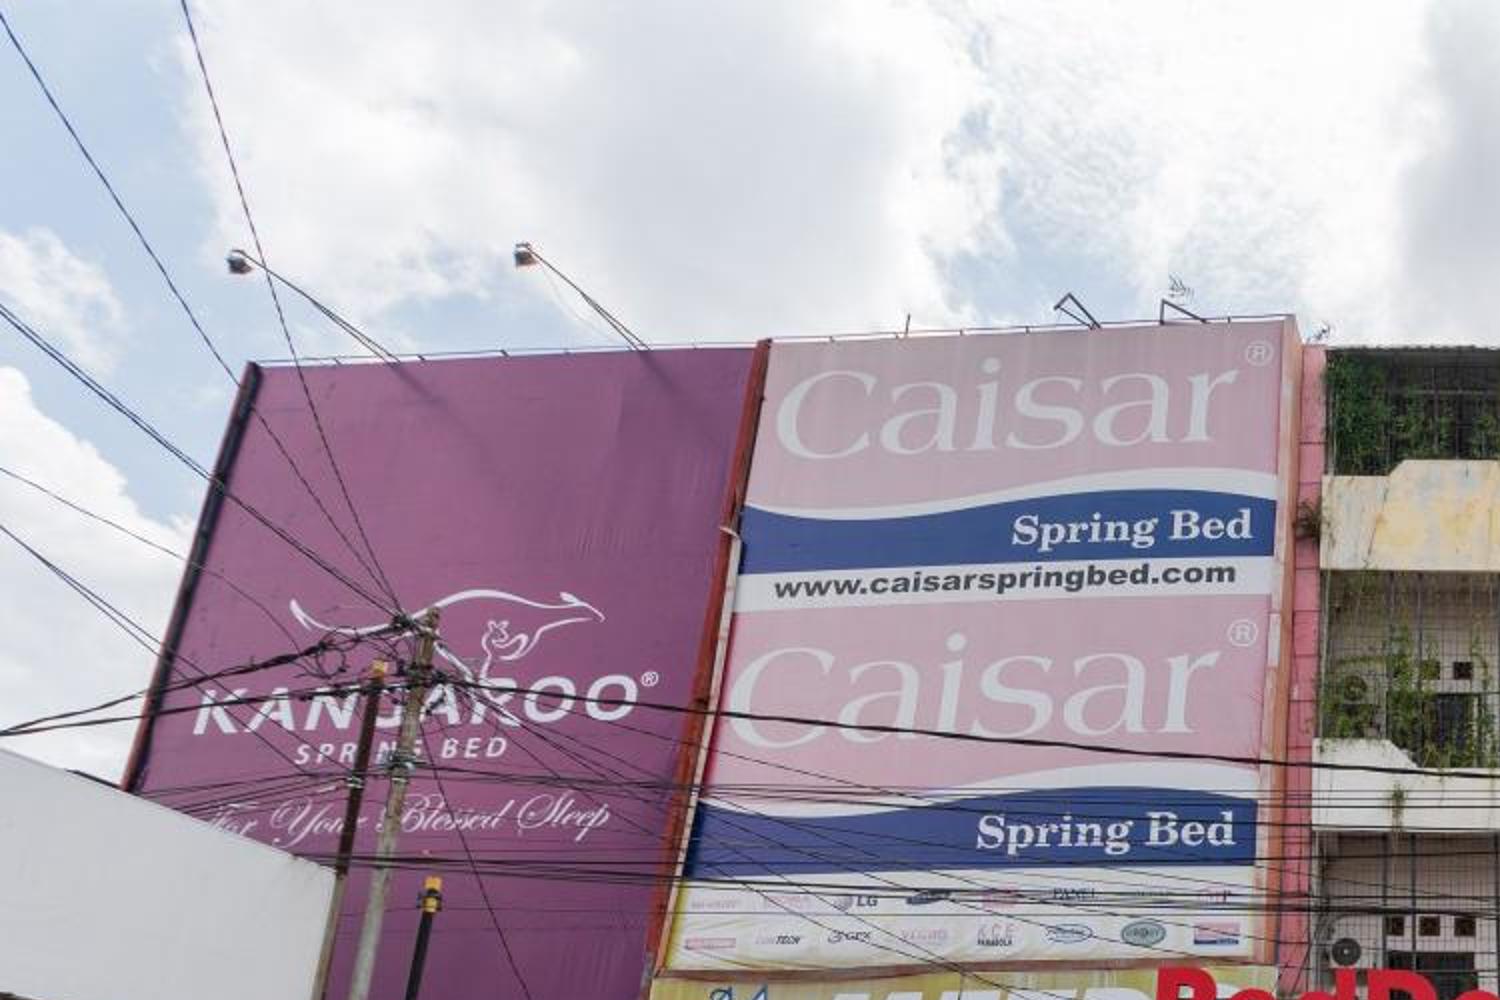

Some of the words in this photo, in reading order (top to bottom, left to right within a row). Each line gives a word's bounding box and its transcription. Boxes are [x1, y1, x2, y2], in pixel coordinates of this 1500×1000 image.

[775, 356, 1239, 461] Caisar
[1010, 512, 1158, 552] Spring
[1169, 507, 1253, 541] Bed
[773, 562, 1237, 599] www.caisarspringbed.com
[728, 632, 1222, 750] Caisar
[440, 737, 508, 759] BED
[516, 791, 611, 843] Sleep
[976, 812, 1134, 856] Spring
[1145, 810, 1236, 847] Bed
